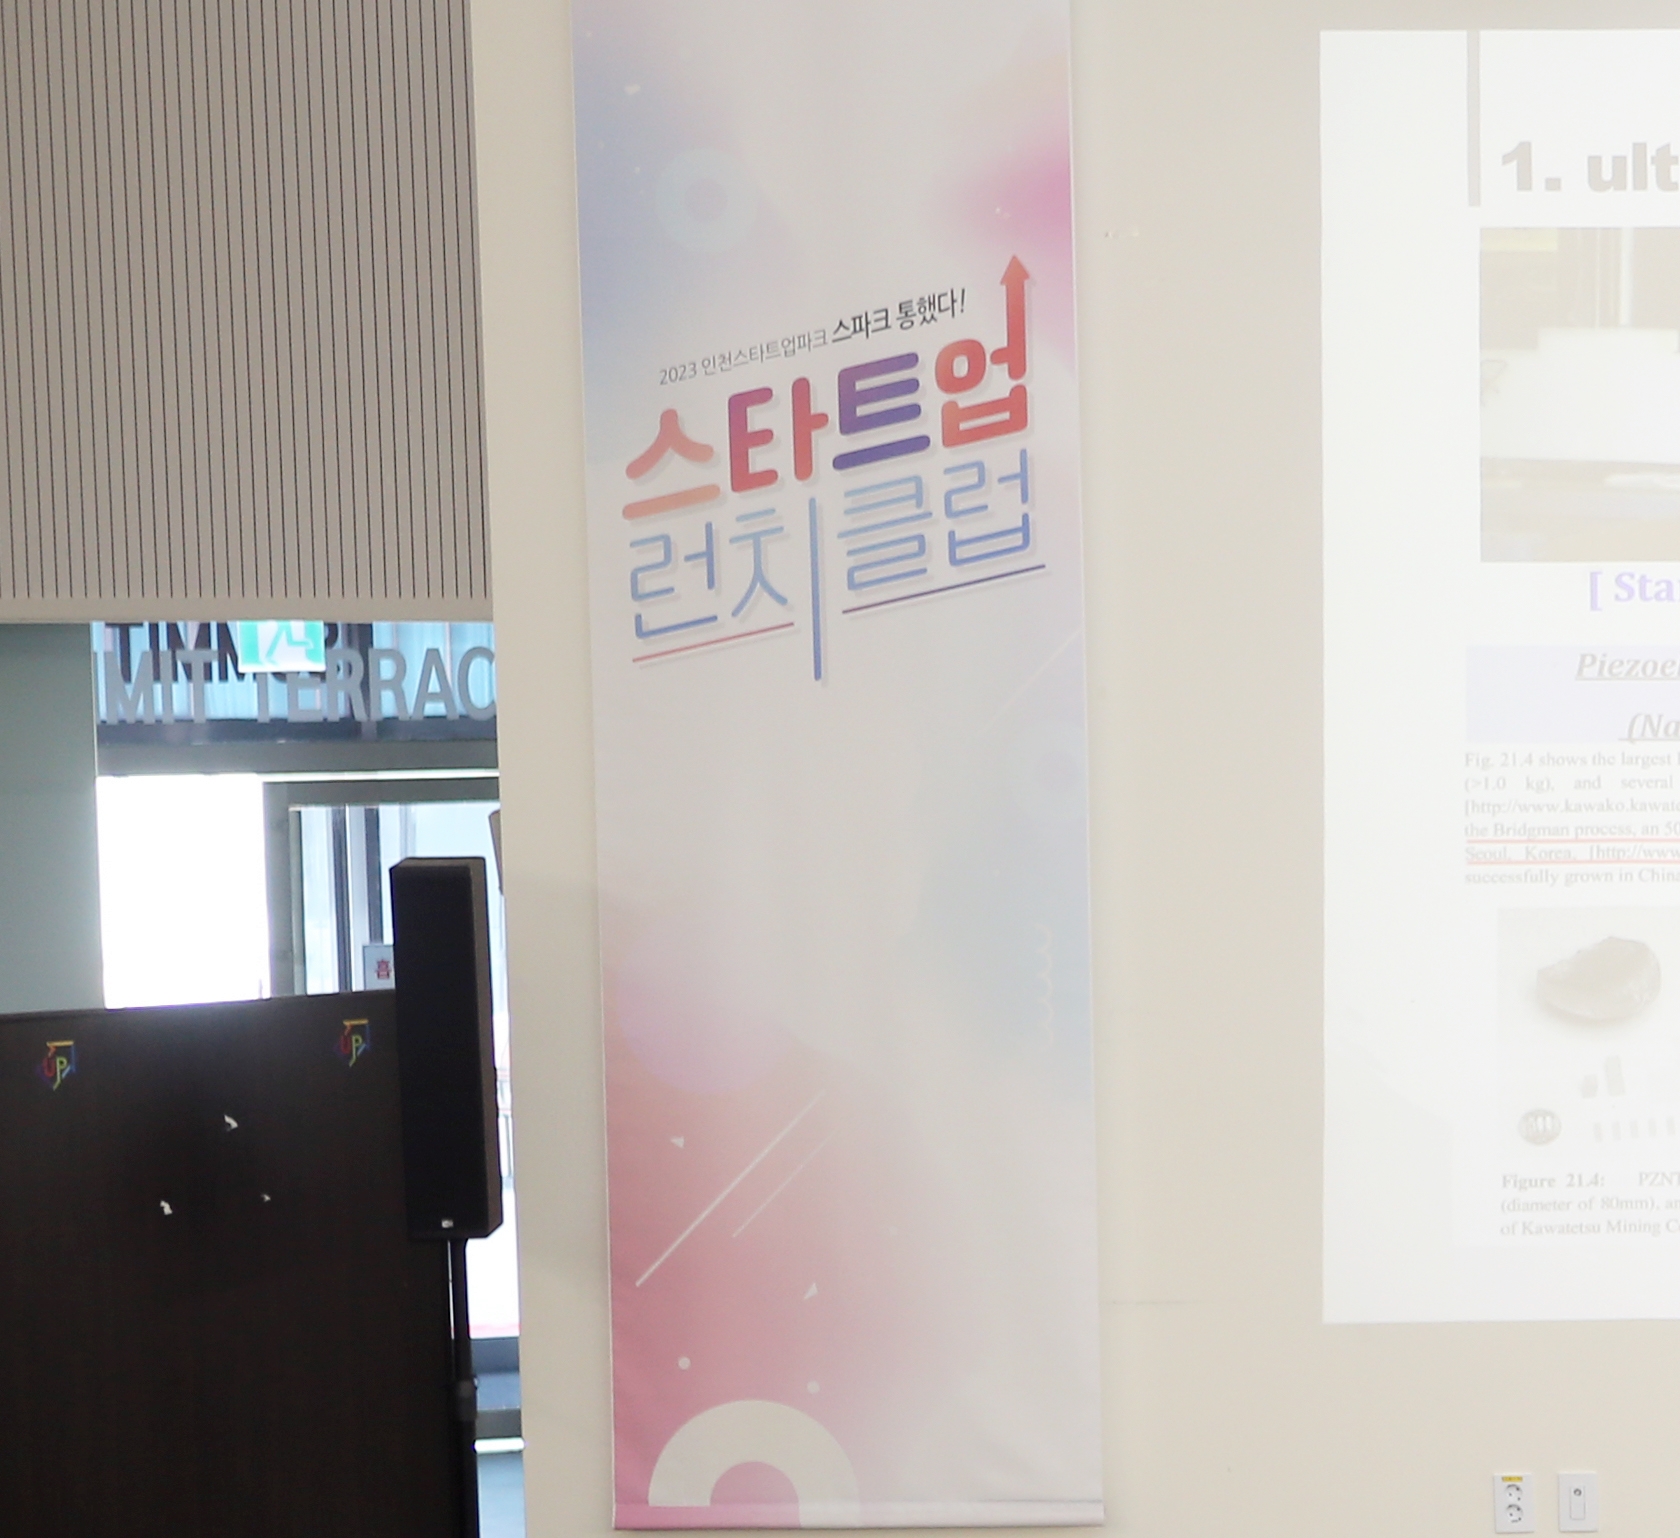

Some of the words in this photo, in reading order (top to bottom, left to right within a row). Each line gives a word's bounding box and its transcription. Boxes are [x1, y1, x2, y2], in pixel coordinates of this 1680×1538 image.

[1501, 140, 1563, 193] 1.
[658, 363, 698, 386] 2023
[700, 328, 829, 377] 인천스타트업파크
[831, 308, 892, 344] 스파크
[895, 287, 967, 331] 통했다!
[622, 255, 1030, 521] 스타트업
[1499, 751, 1535, 769] 21.4
[1538, 751, 1589, 768] shows
[1591, 750, 1617, 768] the
[1620, 750, 1673, 771] largest
